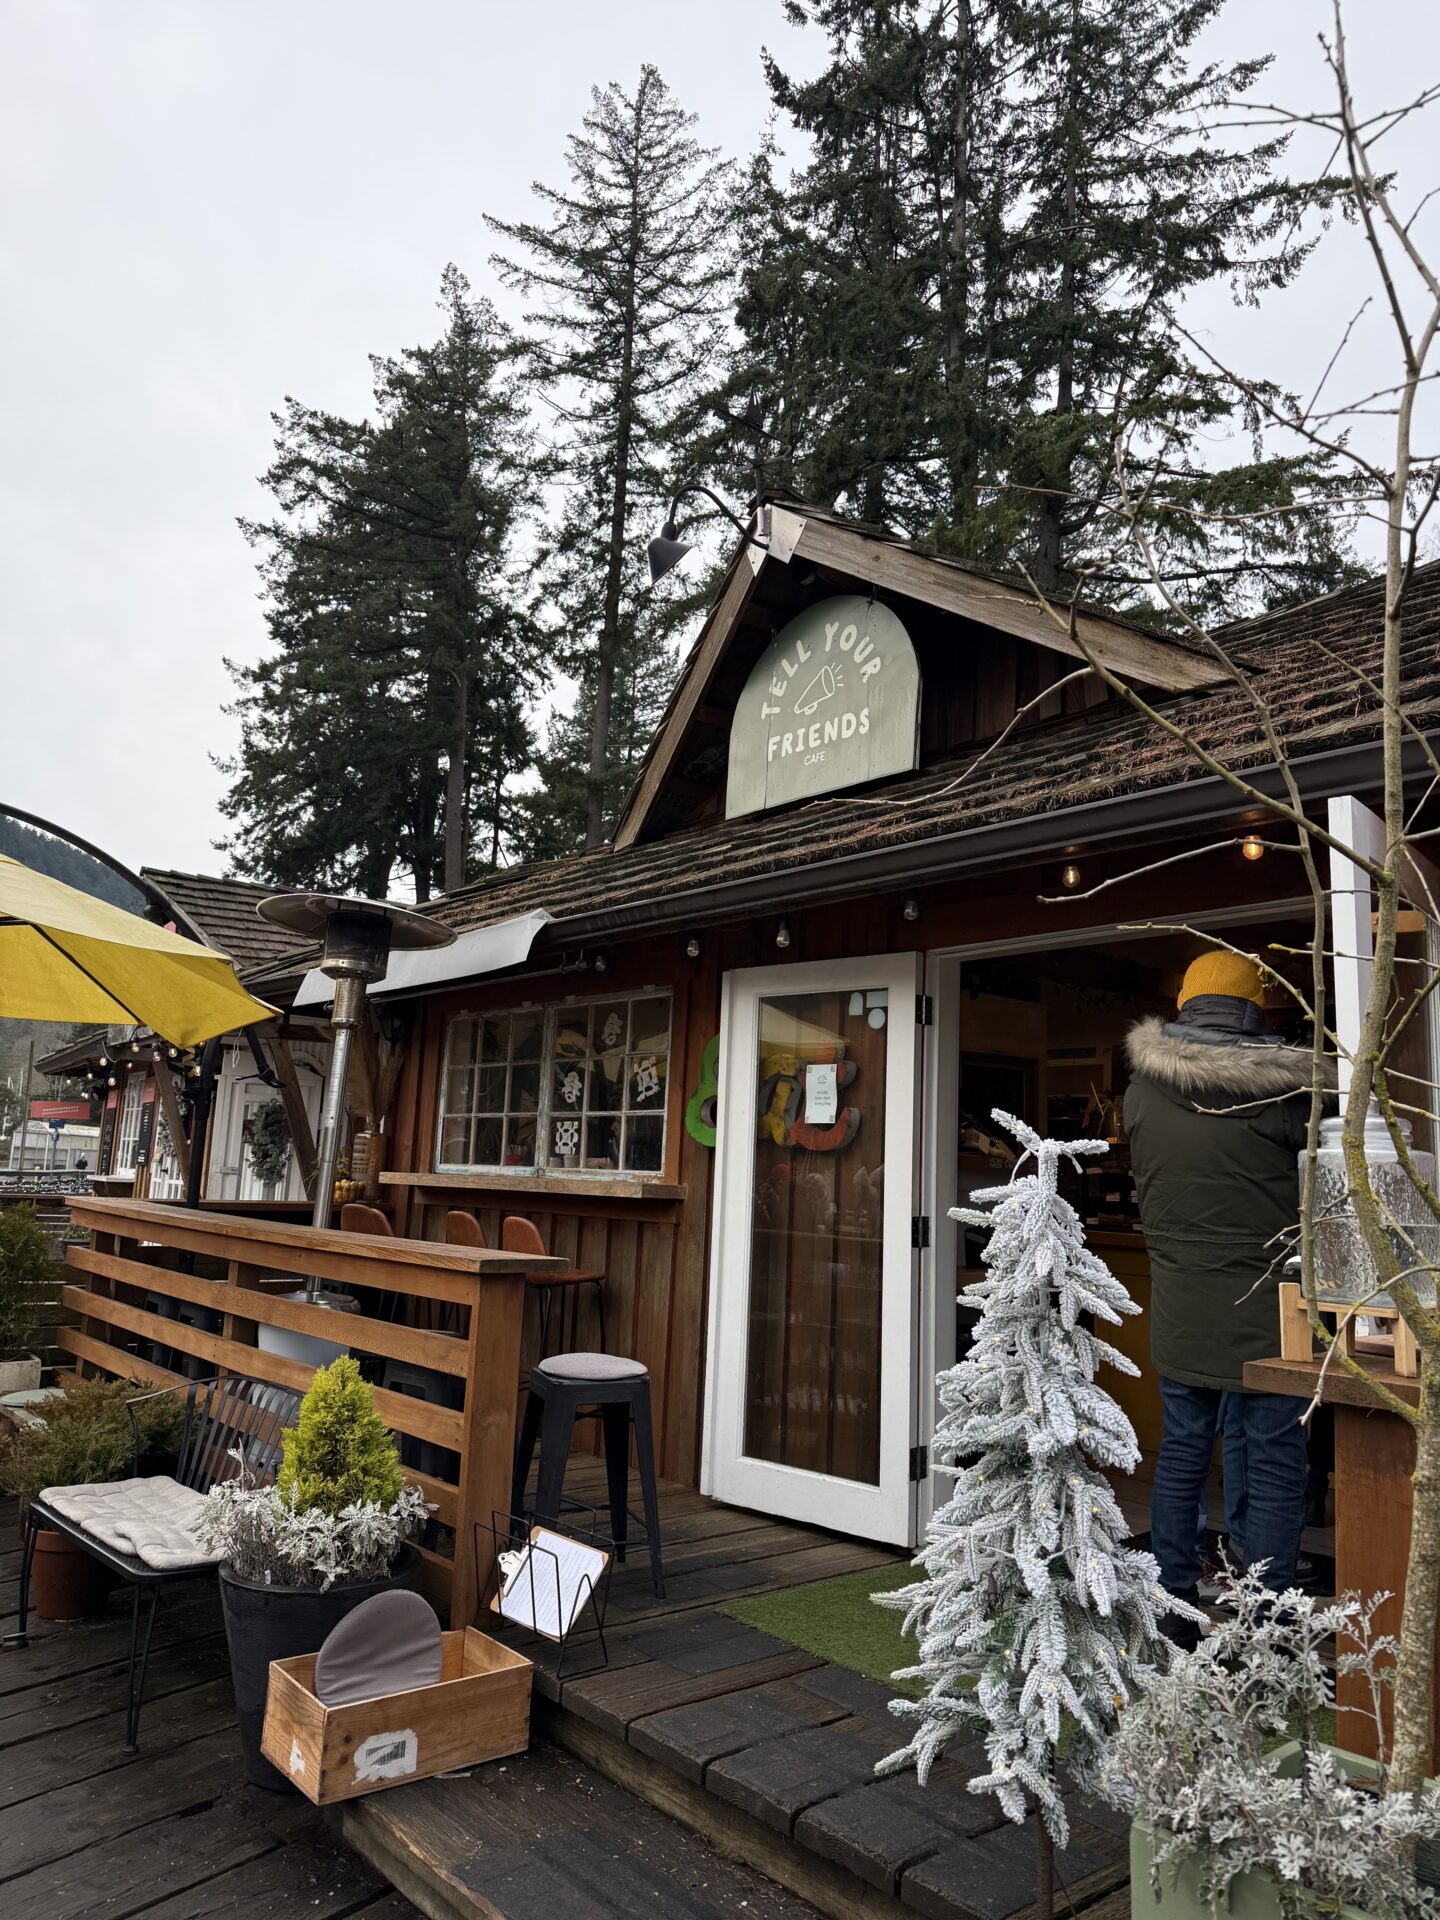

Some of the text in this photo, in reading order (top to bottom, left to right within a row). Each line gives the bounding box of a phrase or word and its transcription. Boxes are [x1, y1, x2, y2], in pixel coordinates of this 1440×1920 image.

[761, 622, 881, 720] TELL YOUR
[768, 707, 870, 762] FRIENDS
[804, 750, 825, 765] CAFE
